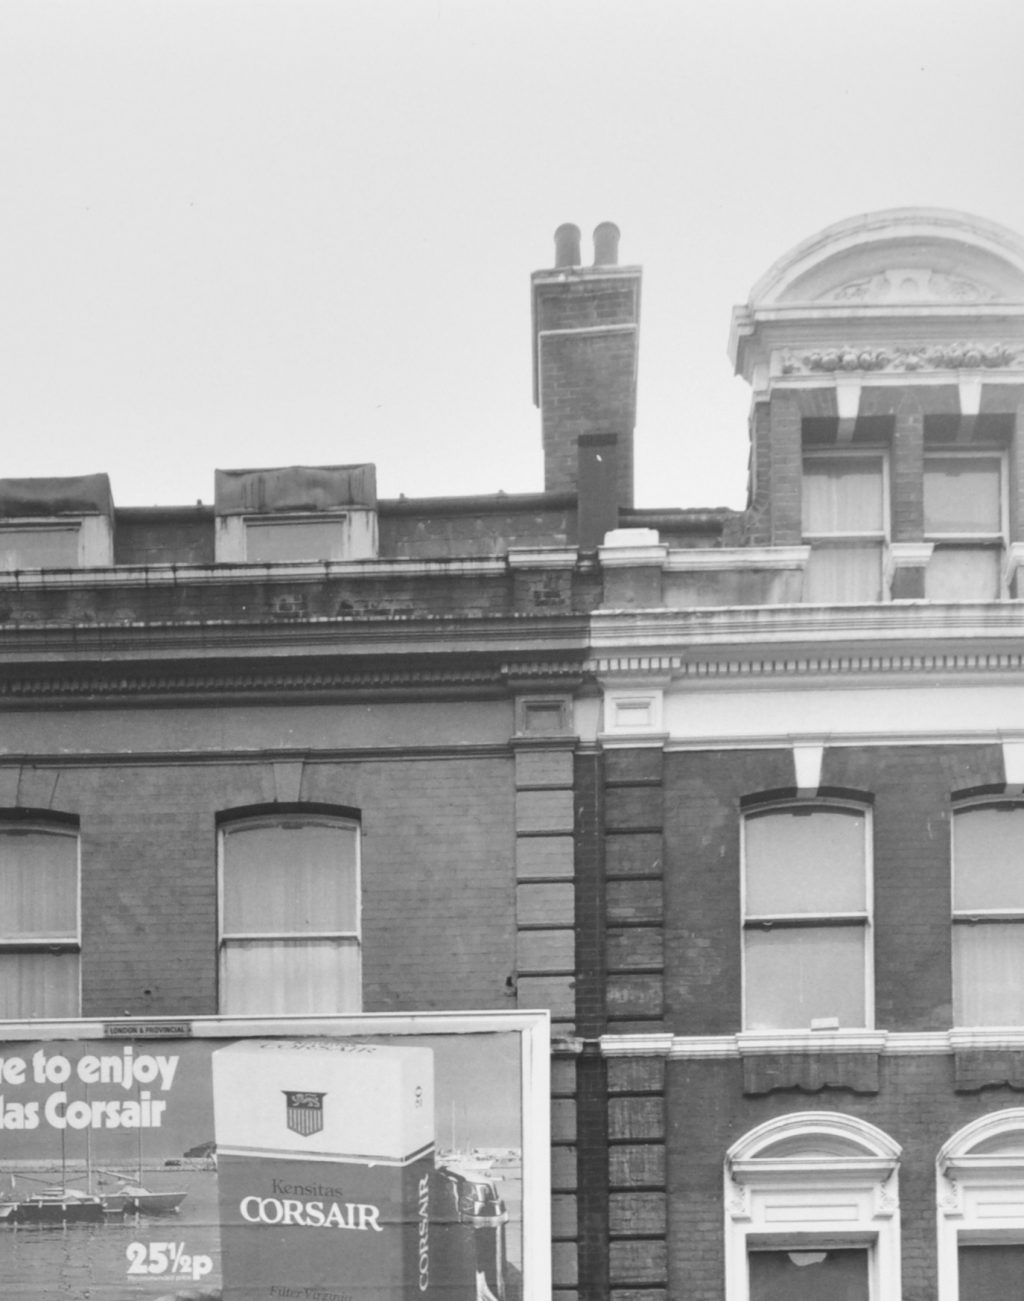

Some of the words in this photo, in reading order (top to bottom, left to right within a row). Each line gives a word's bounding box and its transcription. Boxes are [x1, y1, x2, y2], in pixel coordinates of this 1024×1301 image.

[109, 1026, 137, 1034] LONDON
[145, 1025, 185, 1033] PROVINCIAL
[33, 1049, 72, 1084] to
[77, 1046, 180, 1091] enjoy
[44, 1091, 167, 1130] Corsair
[272, 1178, 344, 1198] Kensitas
[239, 1195, 384, 1232] CORSAIR
[418, 1173, 429, 1292] CORSAIR
